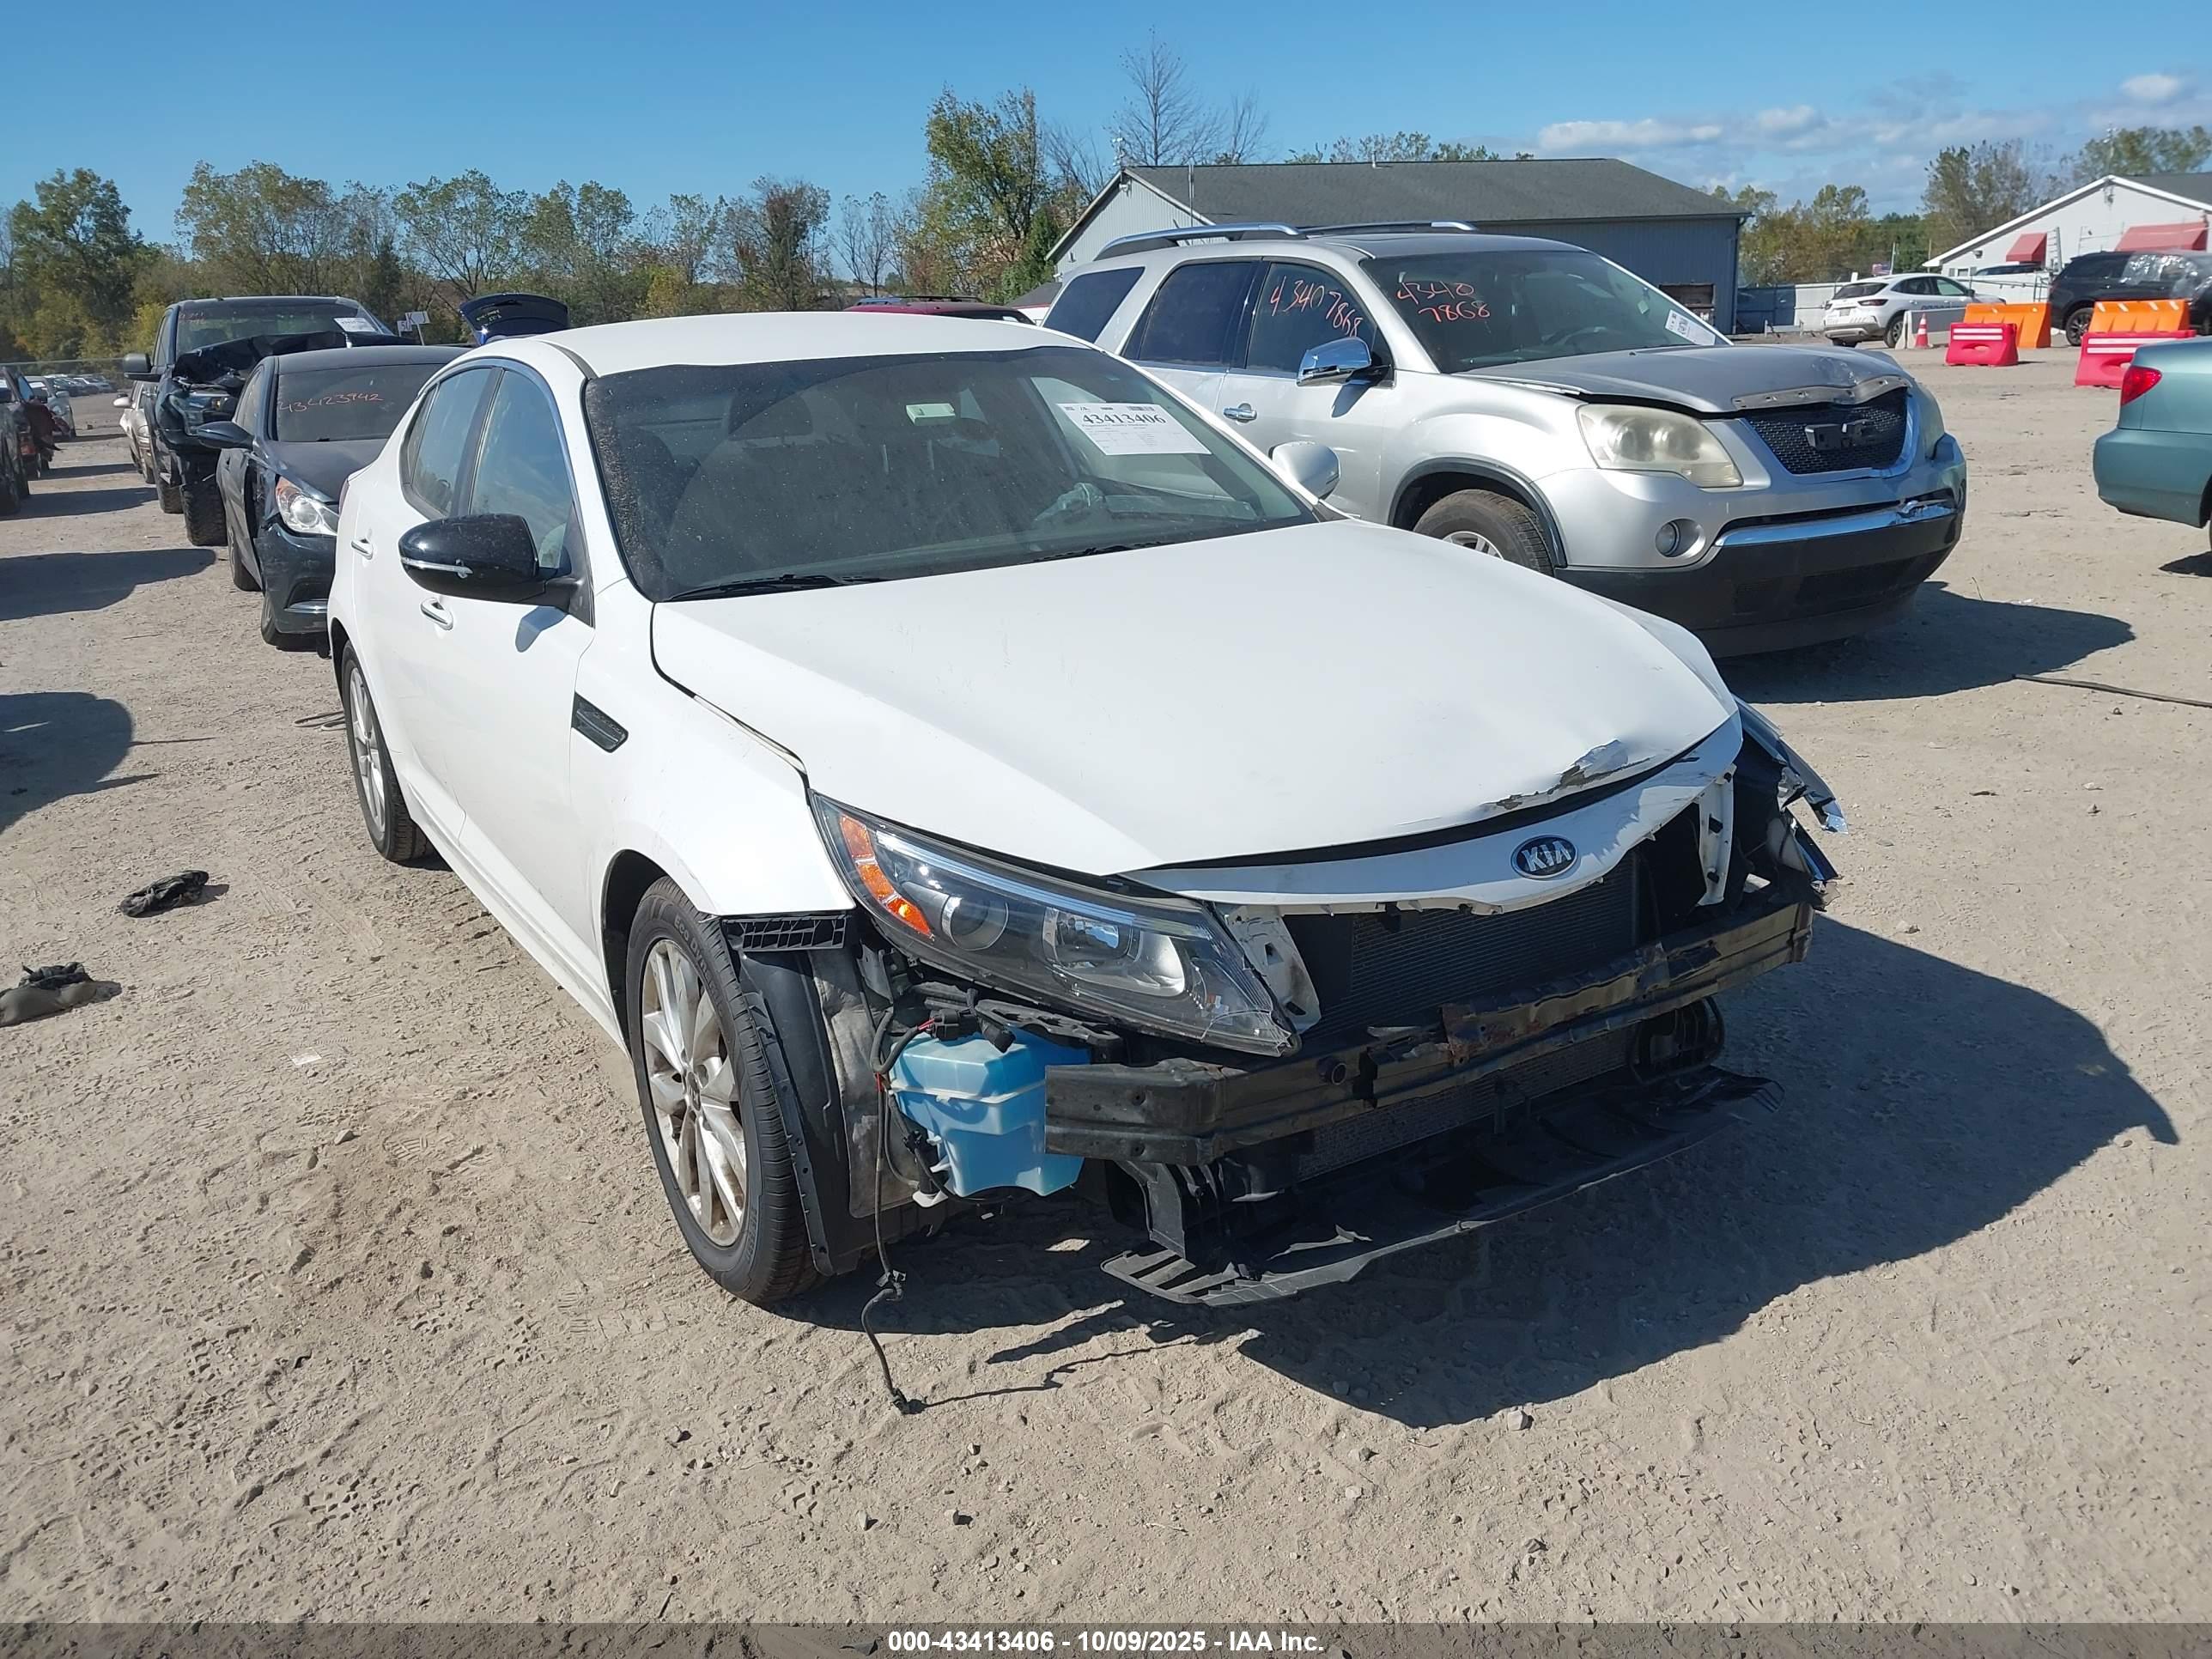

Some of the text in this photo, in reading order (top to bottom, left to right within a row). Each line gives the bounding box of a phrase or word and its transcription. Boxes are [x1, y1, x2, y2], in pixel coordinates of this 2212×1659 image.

[1396, 280, 1474, 305] 4340
[1418, 300, 1491, 323] 7868
[1083, 414, 1166, 424] 43413406
[1521, 840, 1572, 872] KIA
